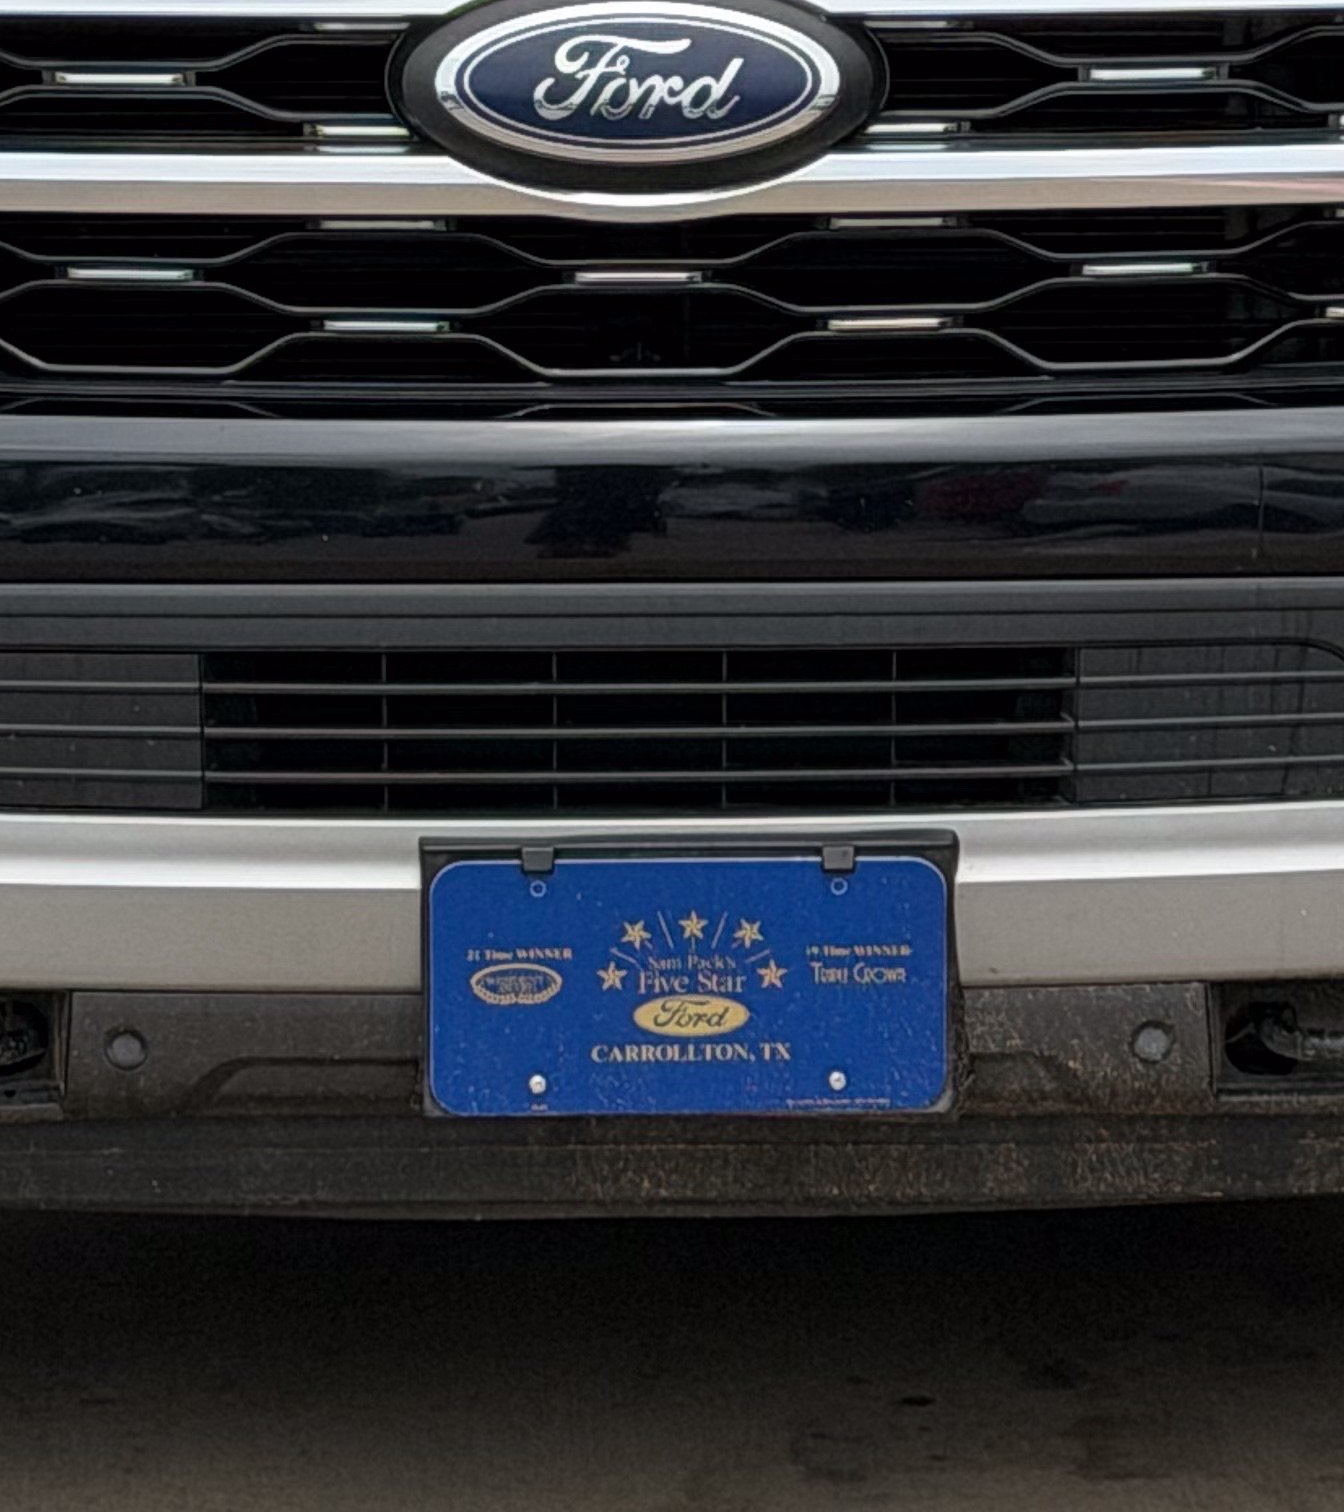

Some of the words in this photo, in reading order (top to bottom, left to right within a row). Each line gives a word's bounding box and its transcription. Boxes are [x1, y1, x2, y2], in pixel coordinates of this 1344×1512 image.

[533, 34, 745, 121] Ford
[515, 947, 573, 961] WINNER
[853, 944, 912, 957] WINNER
[648, 955, 682, 970] Sam
[637, 970, 689, 994] Five
[696, 970, 747, 993] Star
[652, 998, 730, 1028] Ford
[590, 1042, 757, 1064] CARROLLTON,
[760, 1041, 792, 1061] TX
